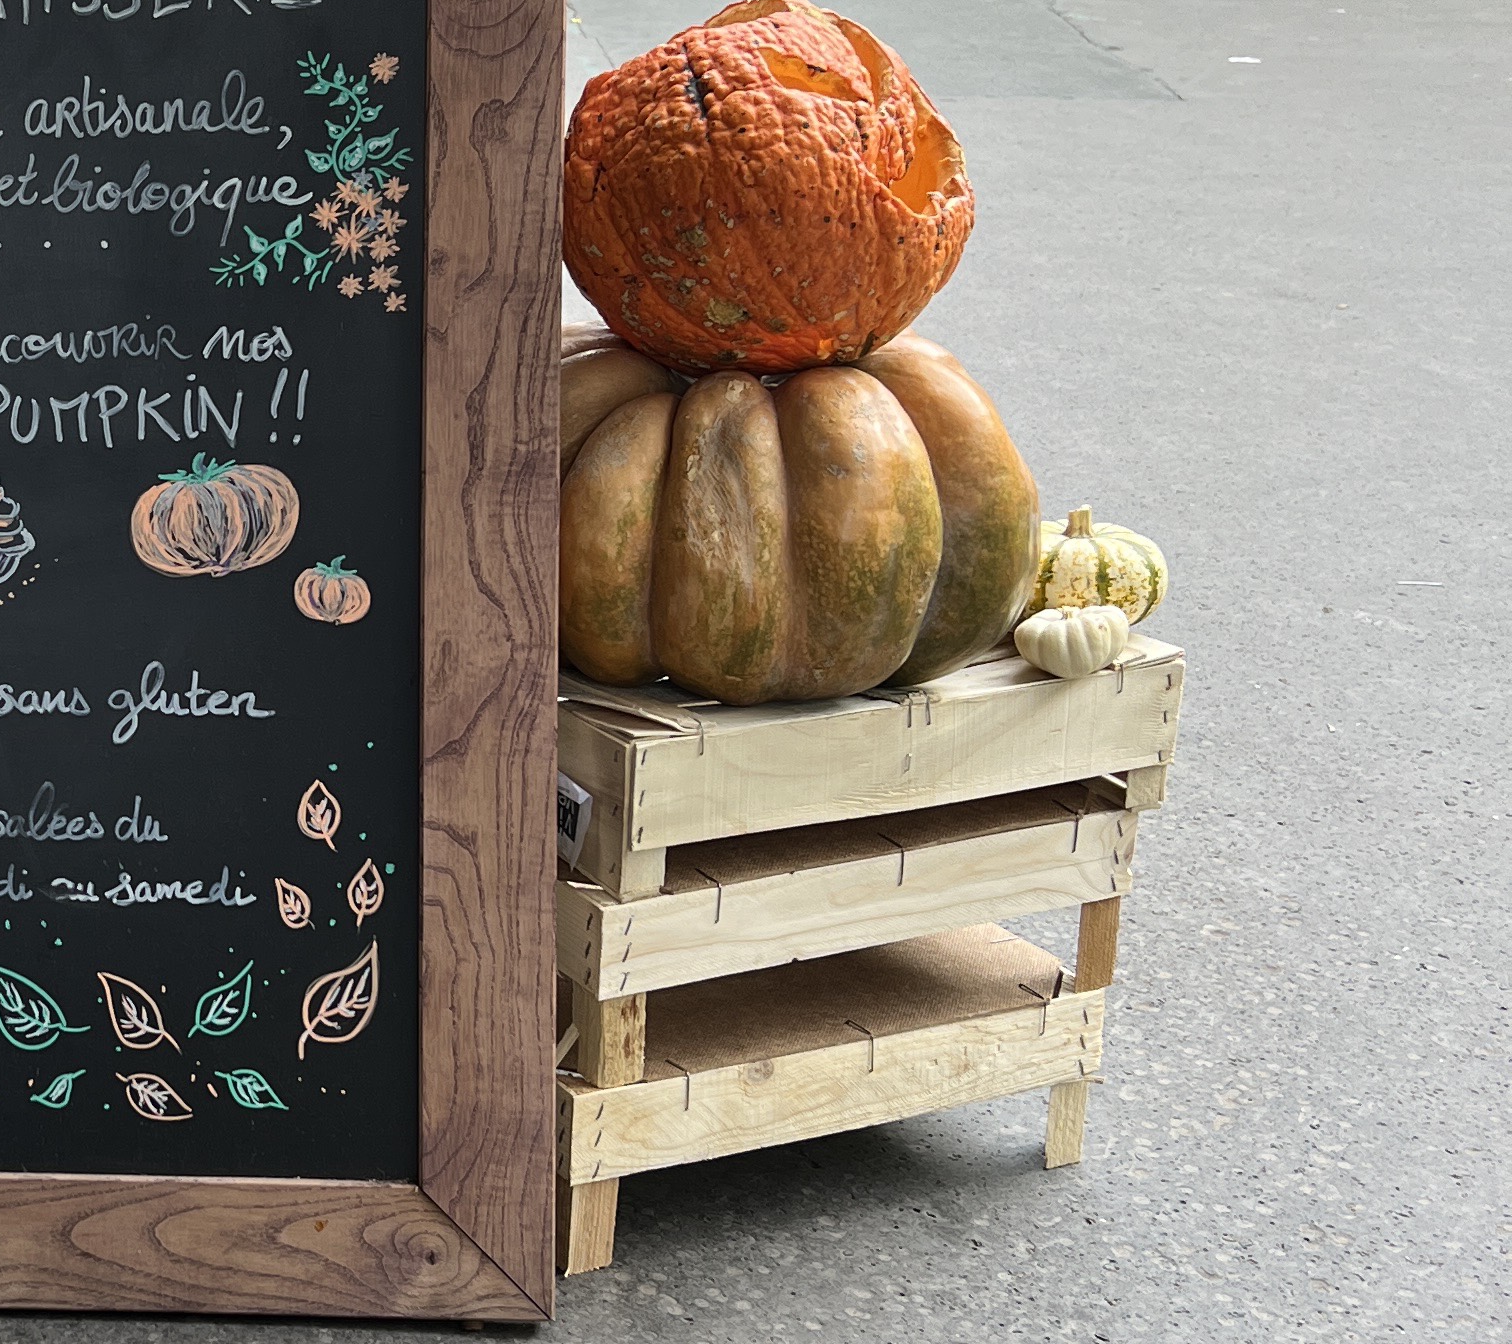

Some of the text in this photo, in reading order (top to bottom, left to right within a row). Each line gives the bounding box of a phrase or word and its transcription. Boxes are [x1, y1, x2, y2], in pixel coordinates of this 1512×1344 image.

[42, 153, 312, 246] biologique
[203, 326, 292, 362] nos
[108, 661, 275, 744] gluten
[115, 796, 168, 842] du
[105, 865, 256, 907] samedi
